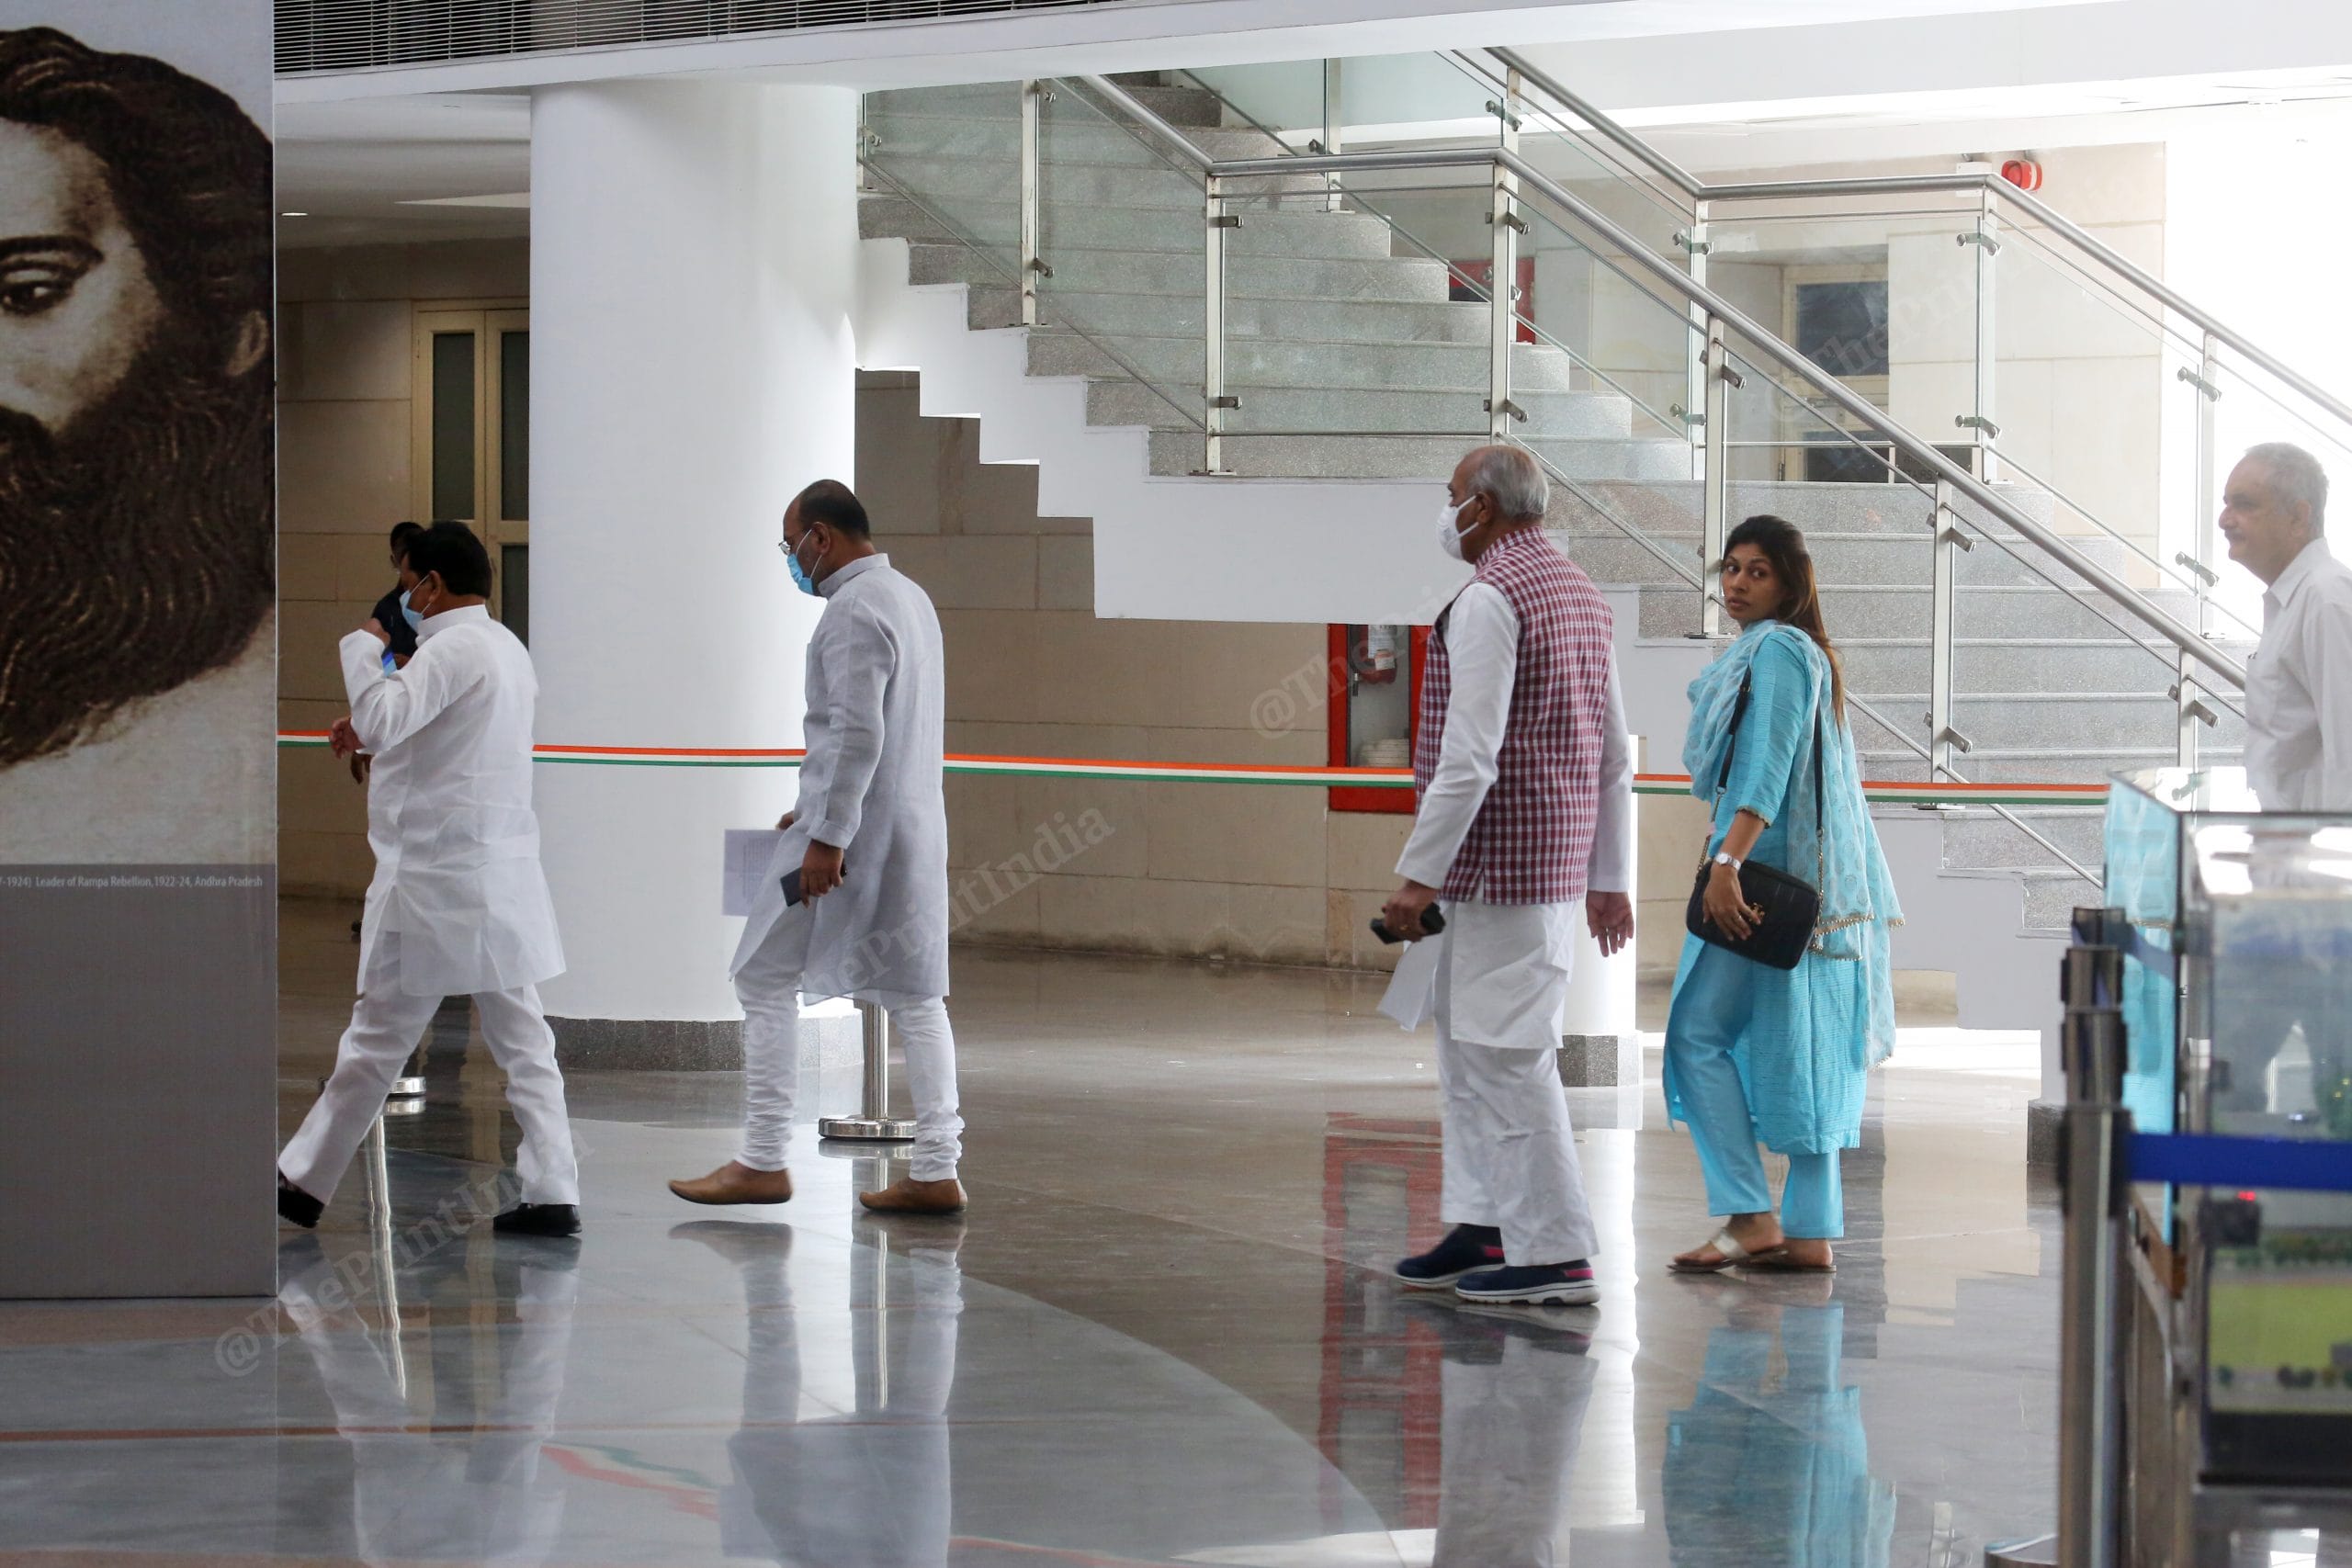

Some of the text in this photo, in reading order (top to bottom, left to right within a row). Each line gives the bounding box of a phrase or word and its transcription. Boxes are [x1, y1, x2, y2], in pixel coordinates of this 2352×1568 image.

[36, 875, 66, 888] Leader
[67, 875, 77, 888] of
[78, 875, 108, 890] Rampa
[195, 875, 226, 888] Andhra
[228, 875, 263, 888] Pradesh
